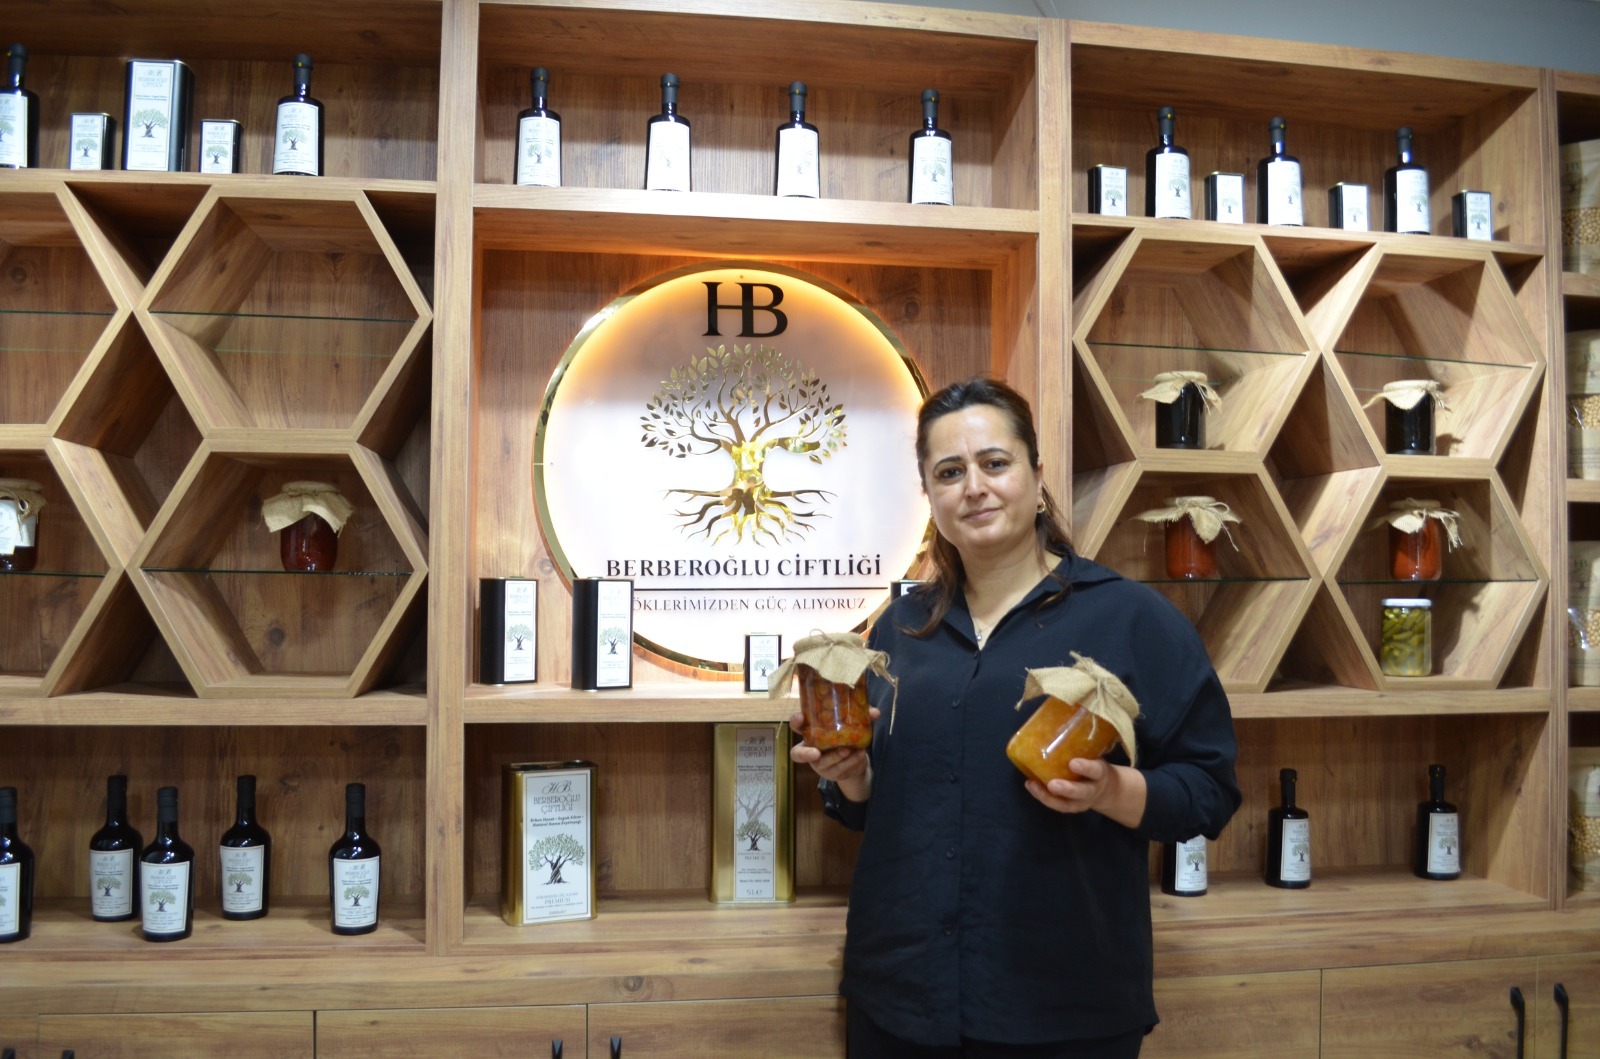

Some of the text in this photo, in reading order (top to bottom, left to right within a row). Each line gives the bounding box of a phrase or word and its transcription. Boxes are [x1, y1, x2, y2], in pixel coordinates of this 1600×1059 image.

[701, 282, 788, 337] HB
[606, 555, 770, 577] BERBEROĞLU
[633, 596, 749, 611] ÖKLERİMİZDEN
[755, 596, 787, 612] GÜÇ
[792, 598, 866, 610] ALIYORUZ
